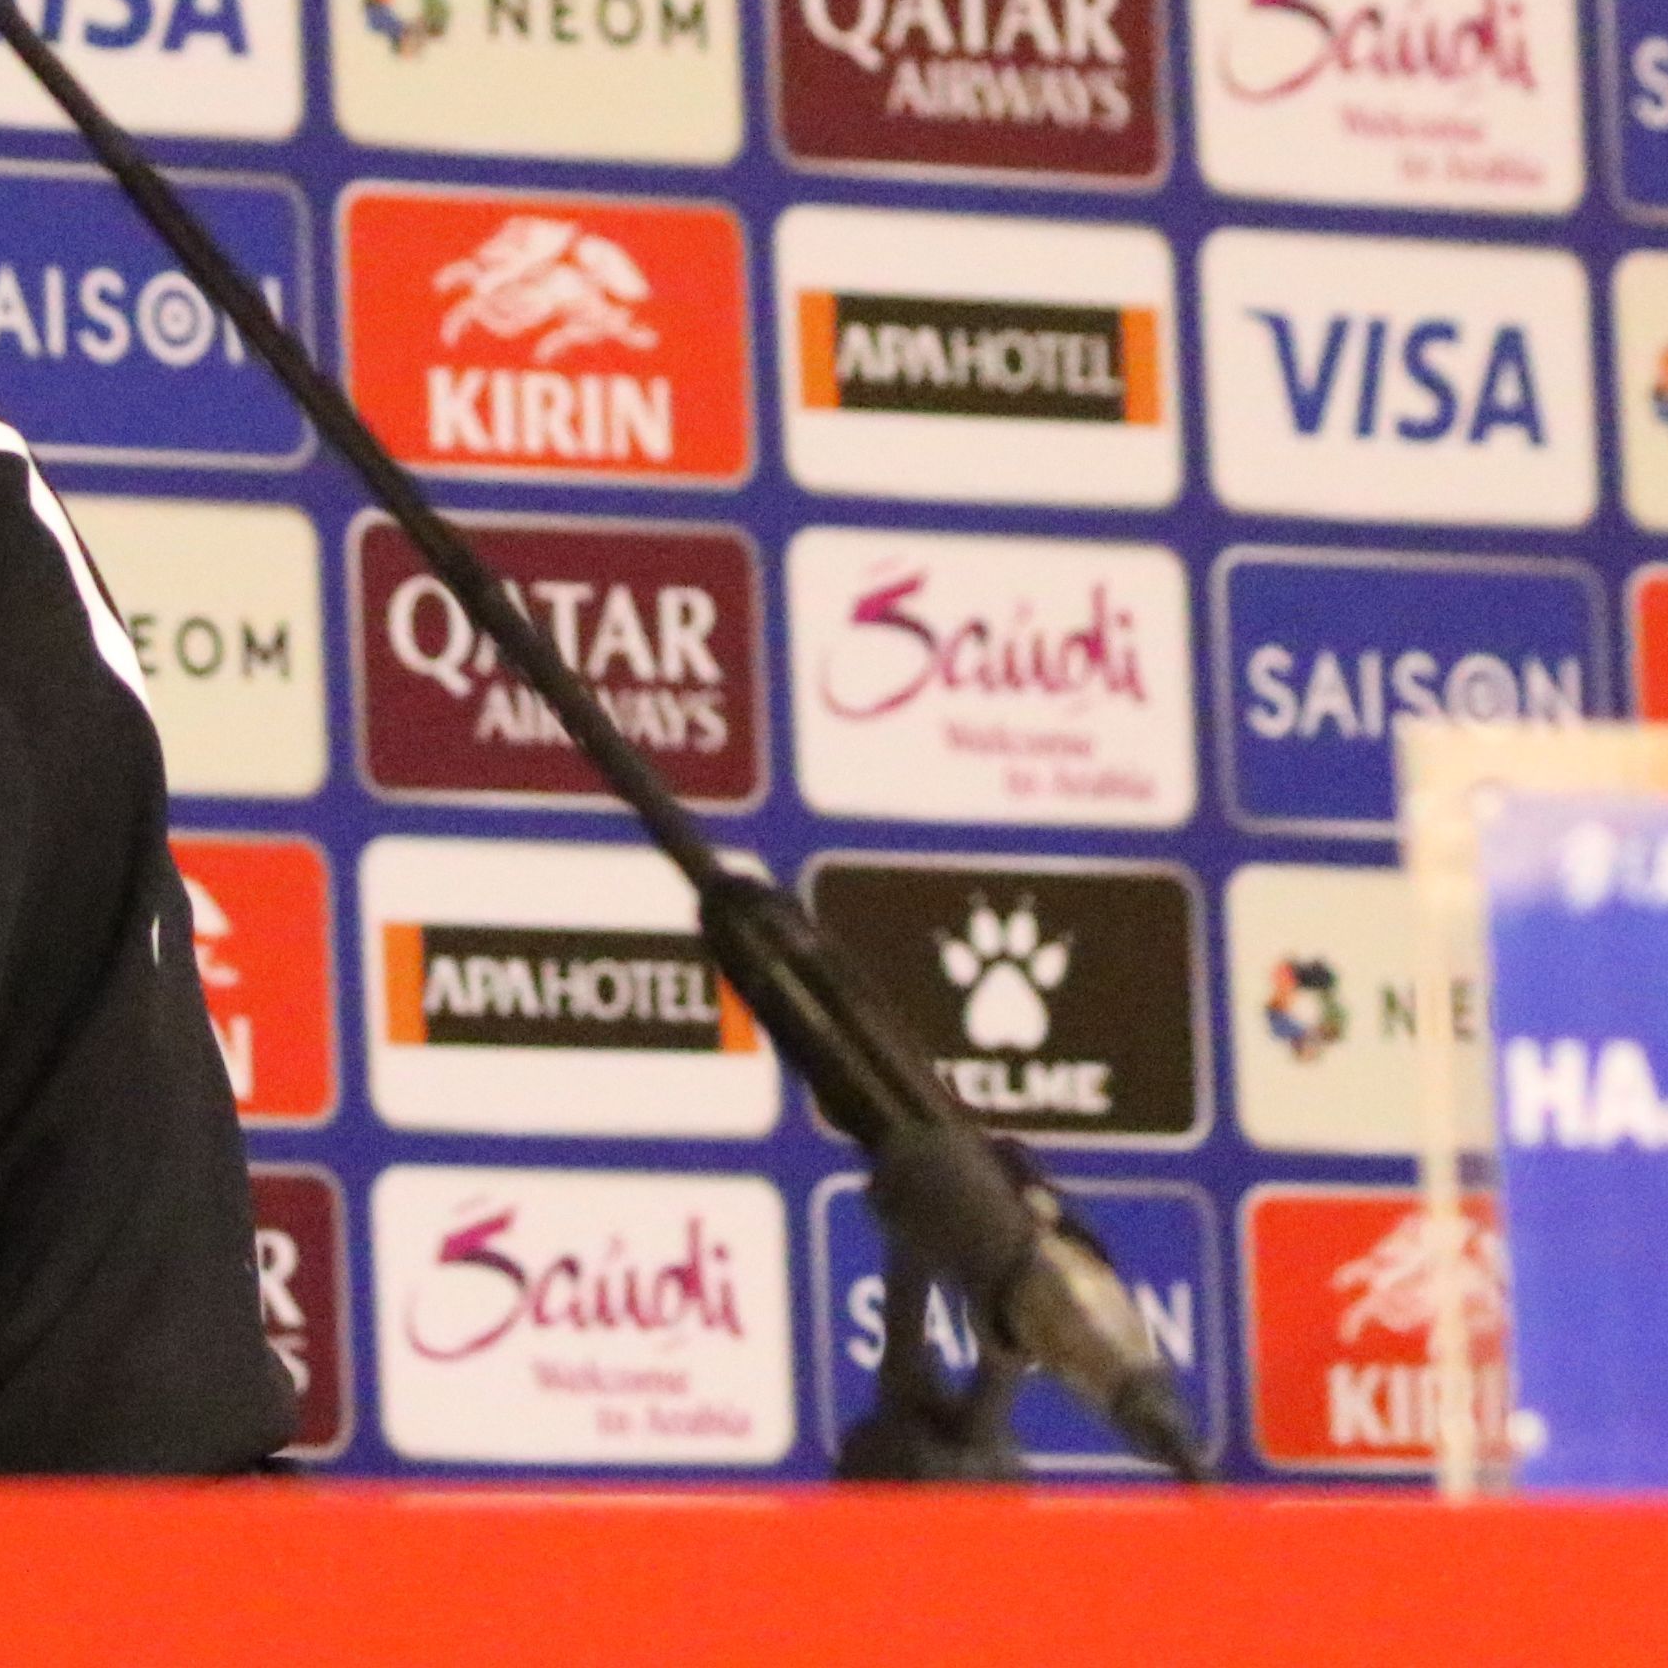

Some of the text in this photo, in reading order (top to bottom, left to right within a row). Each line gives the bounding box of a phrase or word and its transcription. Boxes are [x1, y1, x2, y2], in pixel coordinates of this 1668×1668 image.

[887, 56, 1130, 132] AIRWAYS
[427, 365, 673, 460] KIRIN
[1246, 306, 1548, 448] VISA
[131, 613, 291, 679] EOM
[1248, 644, 1583, 738] SAISON
